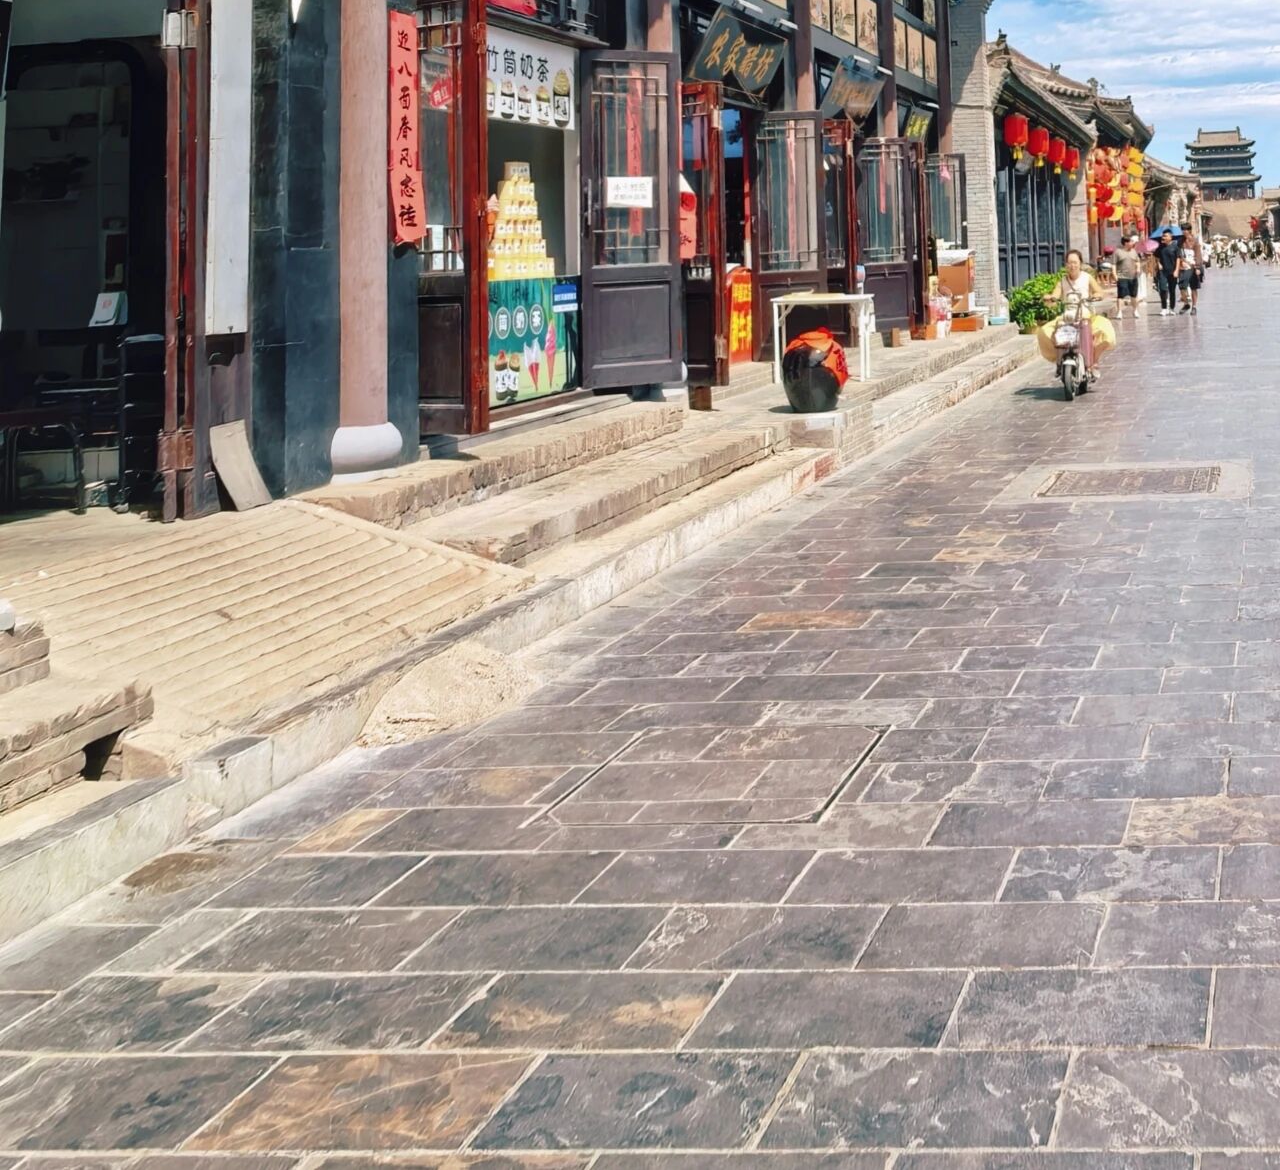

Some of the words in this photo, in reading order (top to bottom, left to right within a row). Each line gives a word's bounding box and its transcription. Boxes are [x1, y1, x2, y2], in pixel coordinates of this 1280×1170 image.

[486, 44, 550, 83] 竹筒奶茶
[498, 310, 542, 332] 筒奶茶
